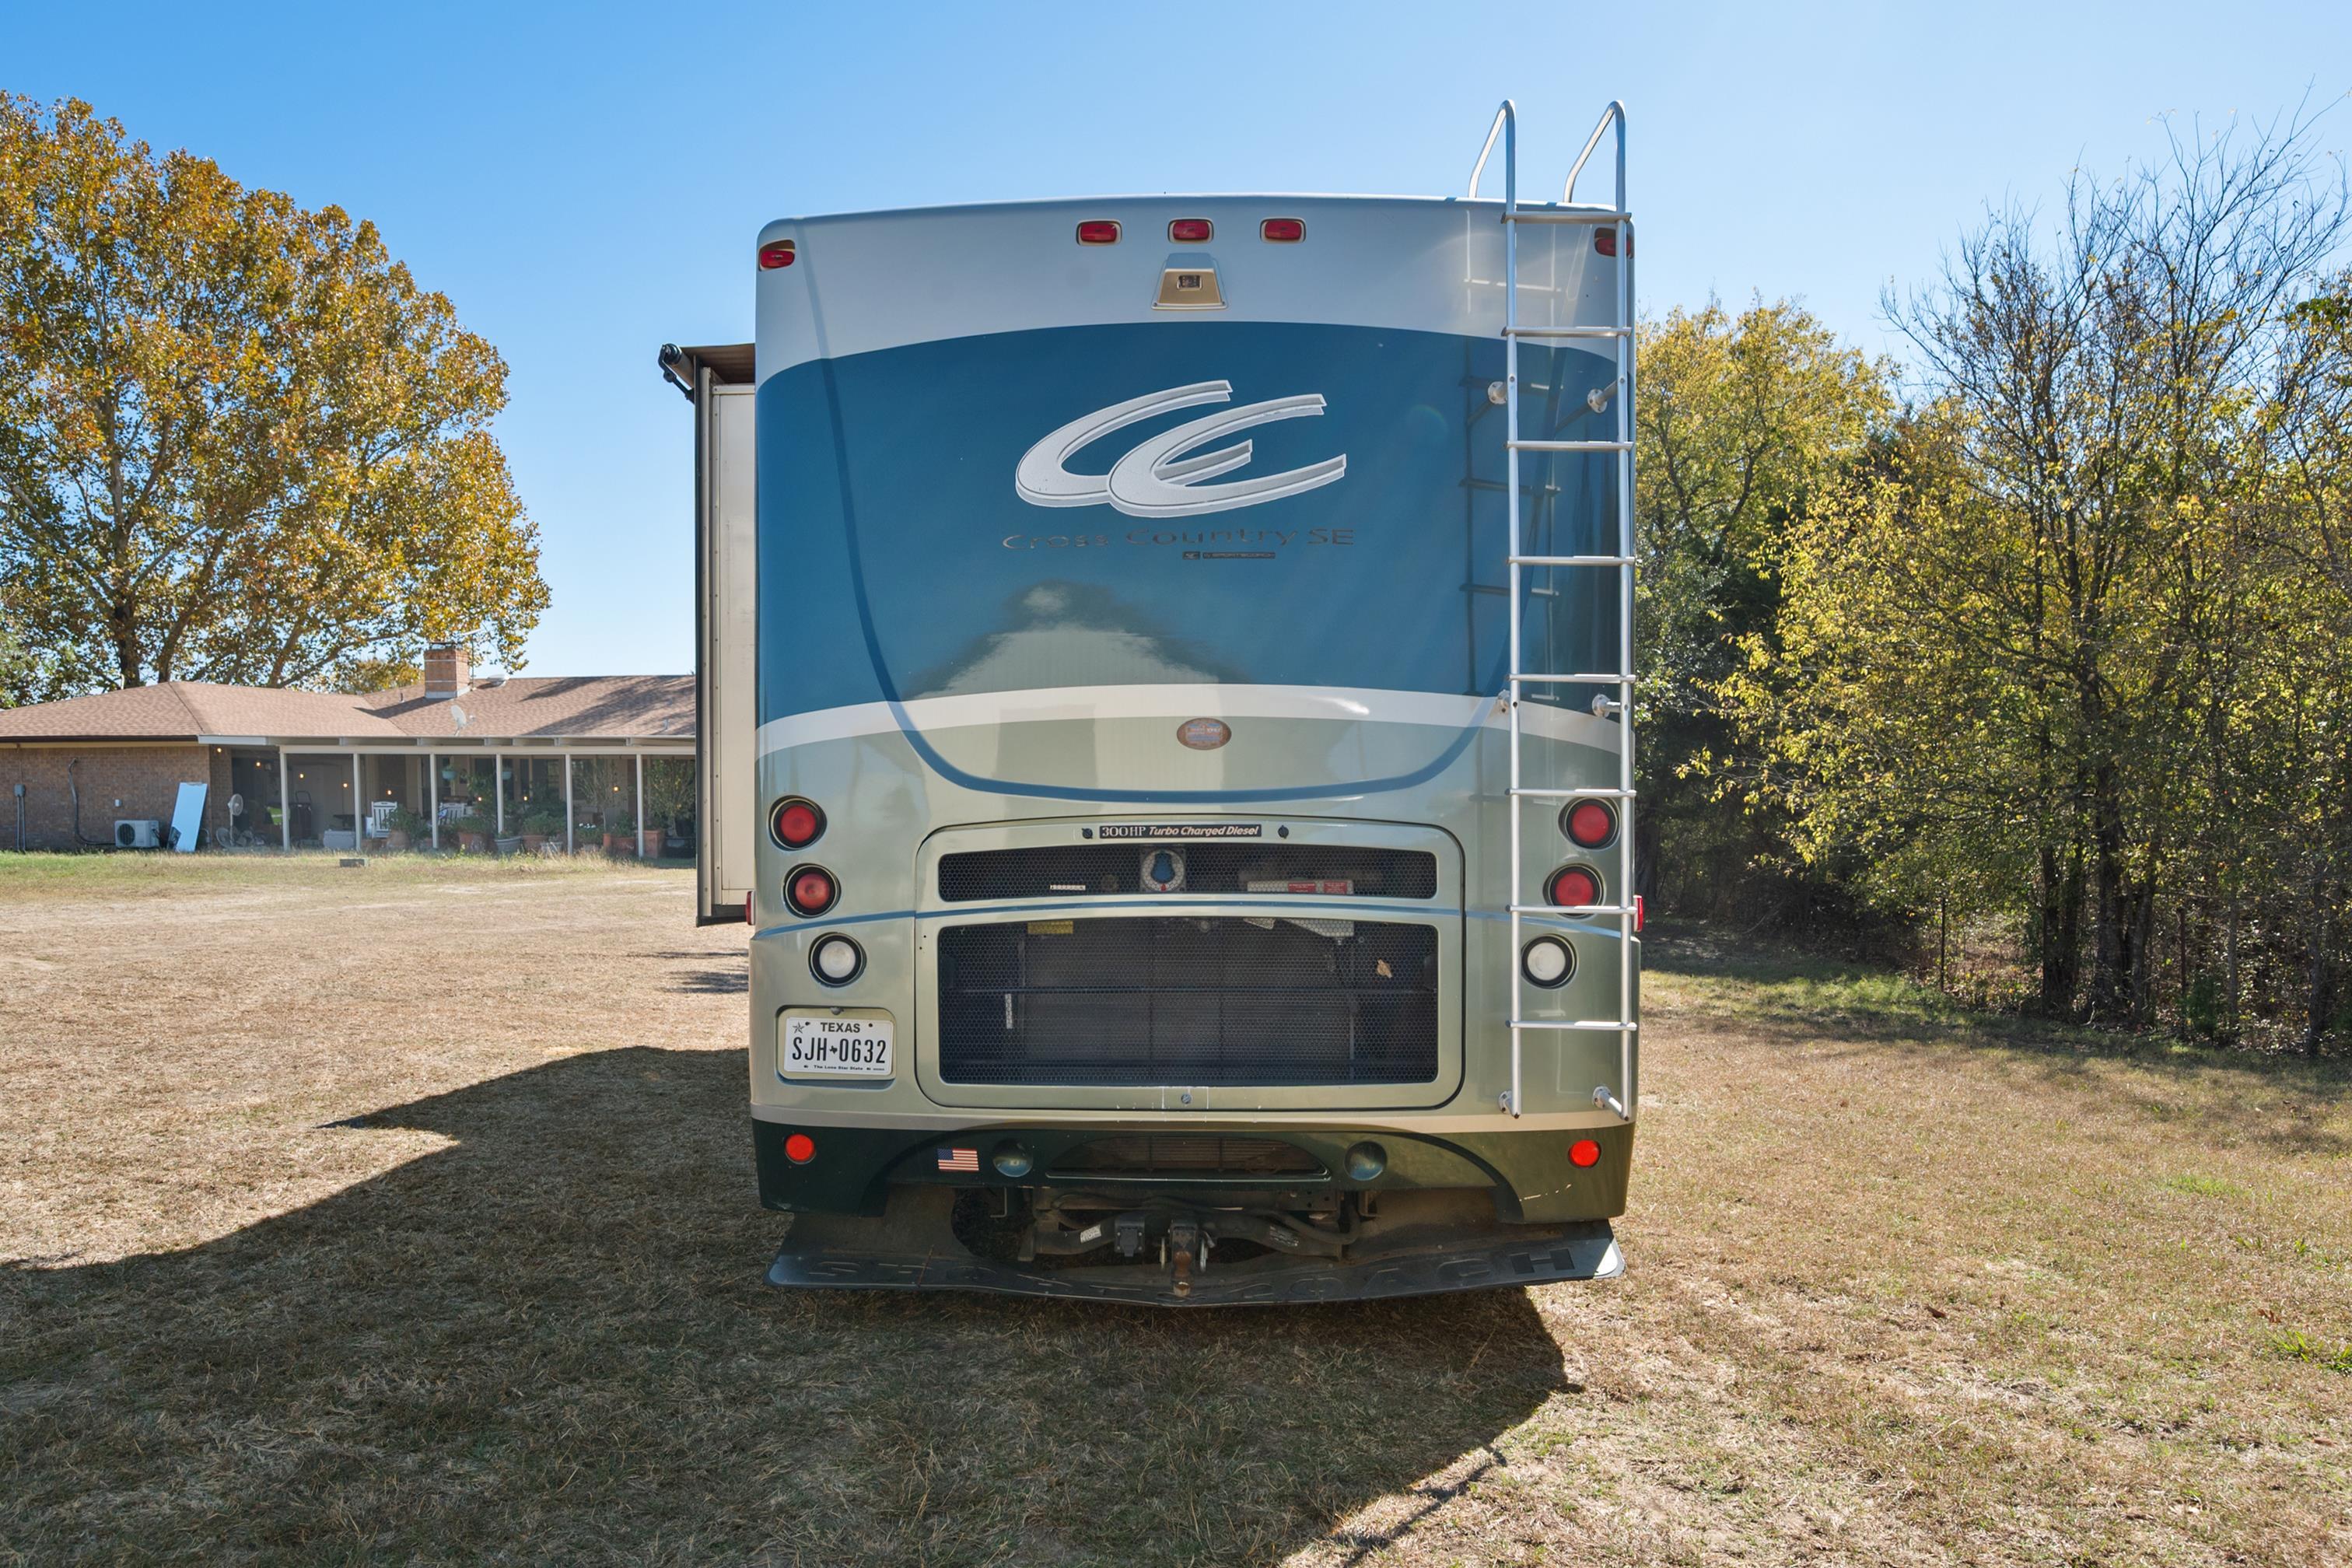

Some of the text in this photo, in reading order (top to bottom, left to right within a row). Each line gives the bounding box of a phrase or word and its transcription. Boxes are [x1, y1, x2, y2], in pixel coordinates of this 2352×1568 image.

[1003, 528, 1354, 549] Cross Country SE
[1149, 826, 1179, 835] Turbo
[1181, 826, 1227, 837] Charged
[1226, 825, 1259, 835] Diesel
[821, 1022, 860, 1033] TEXAS
[792, 1037, 887, 1063] SJH 0632
